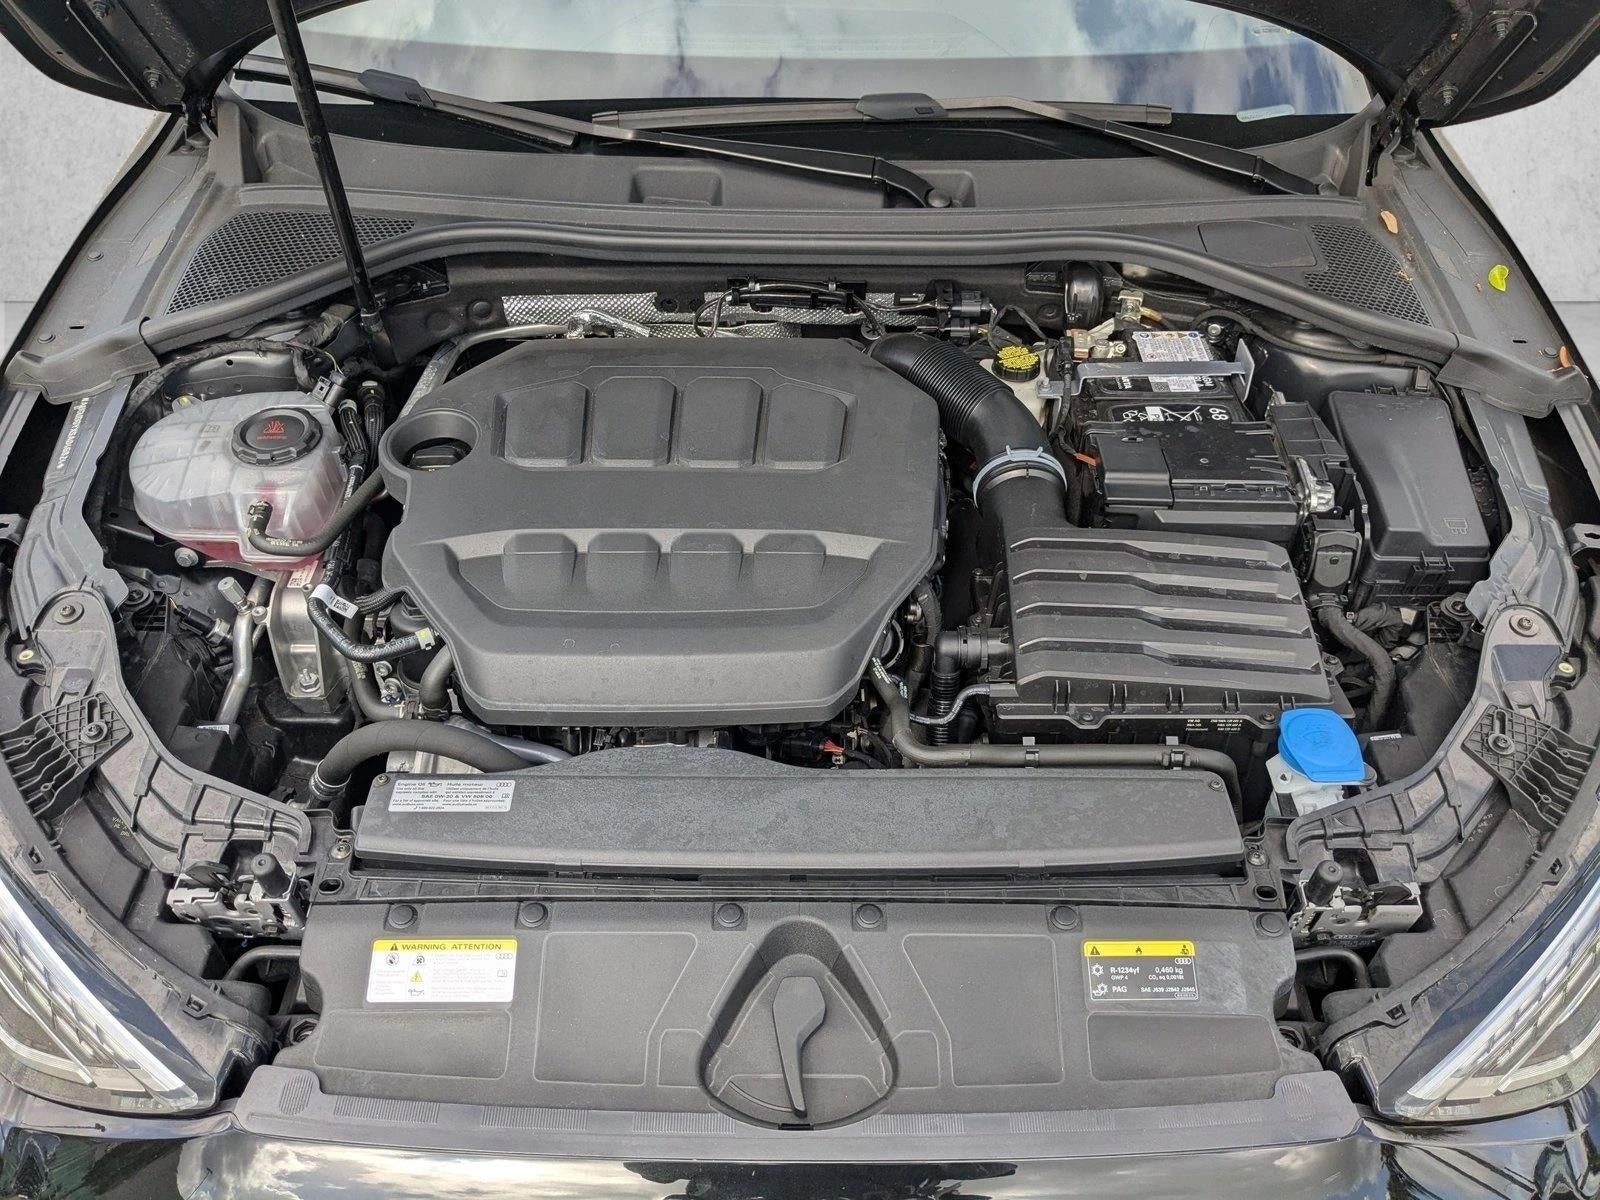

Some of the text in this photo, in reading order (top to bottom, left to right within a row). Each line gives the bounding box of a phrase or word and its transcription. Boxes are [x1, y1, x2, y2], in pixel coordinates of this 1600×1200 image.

[1209, 407, 1229, 420] 68
[402, 943, 446, 951] WARNING
[1110, 966, 1140, 975] R-1234yf
[1175, 966, 1183, 974] kg
